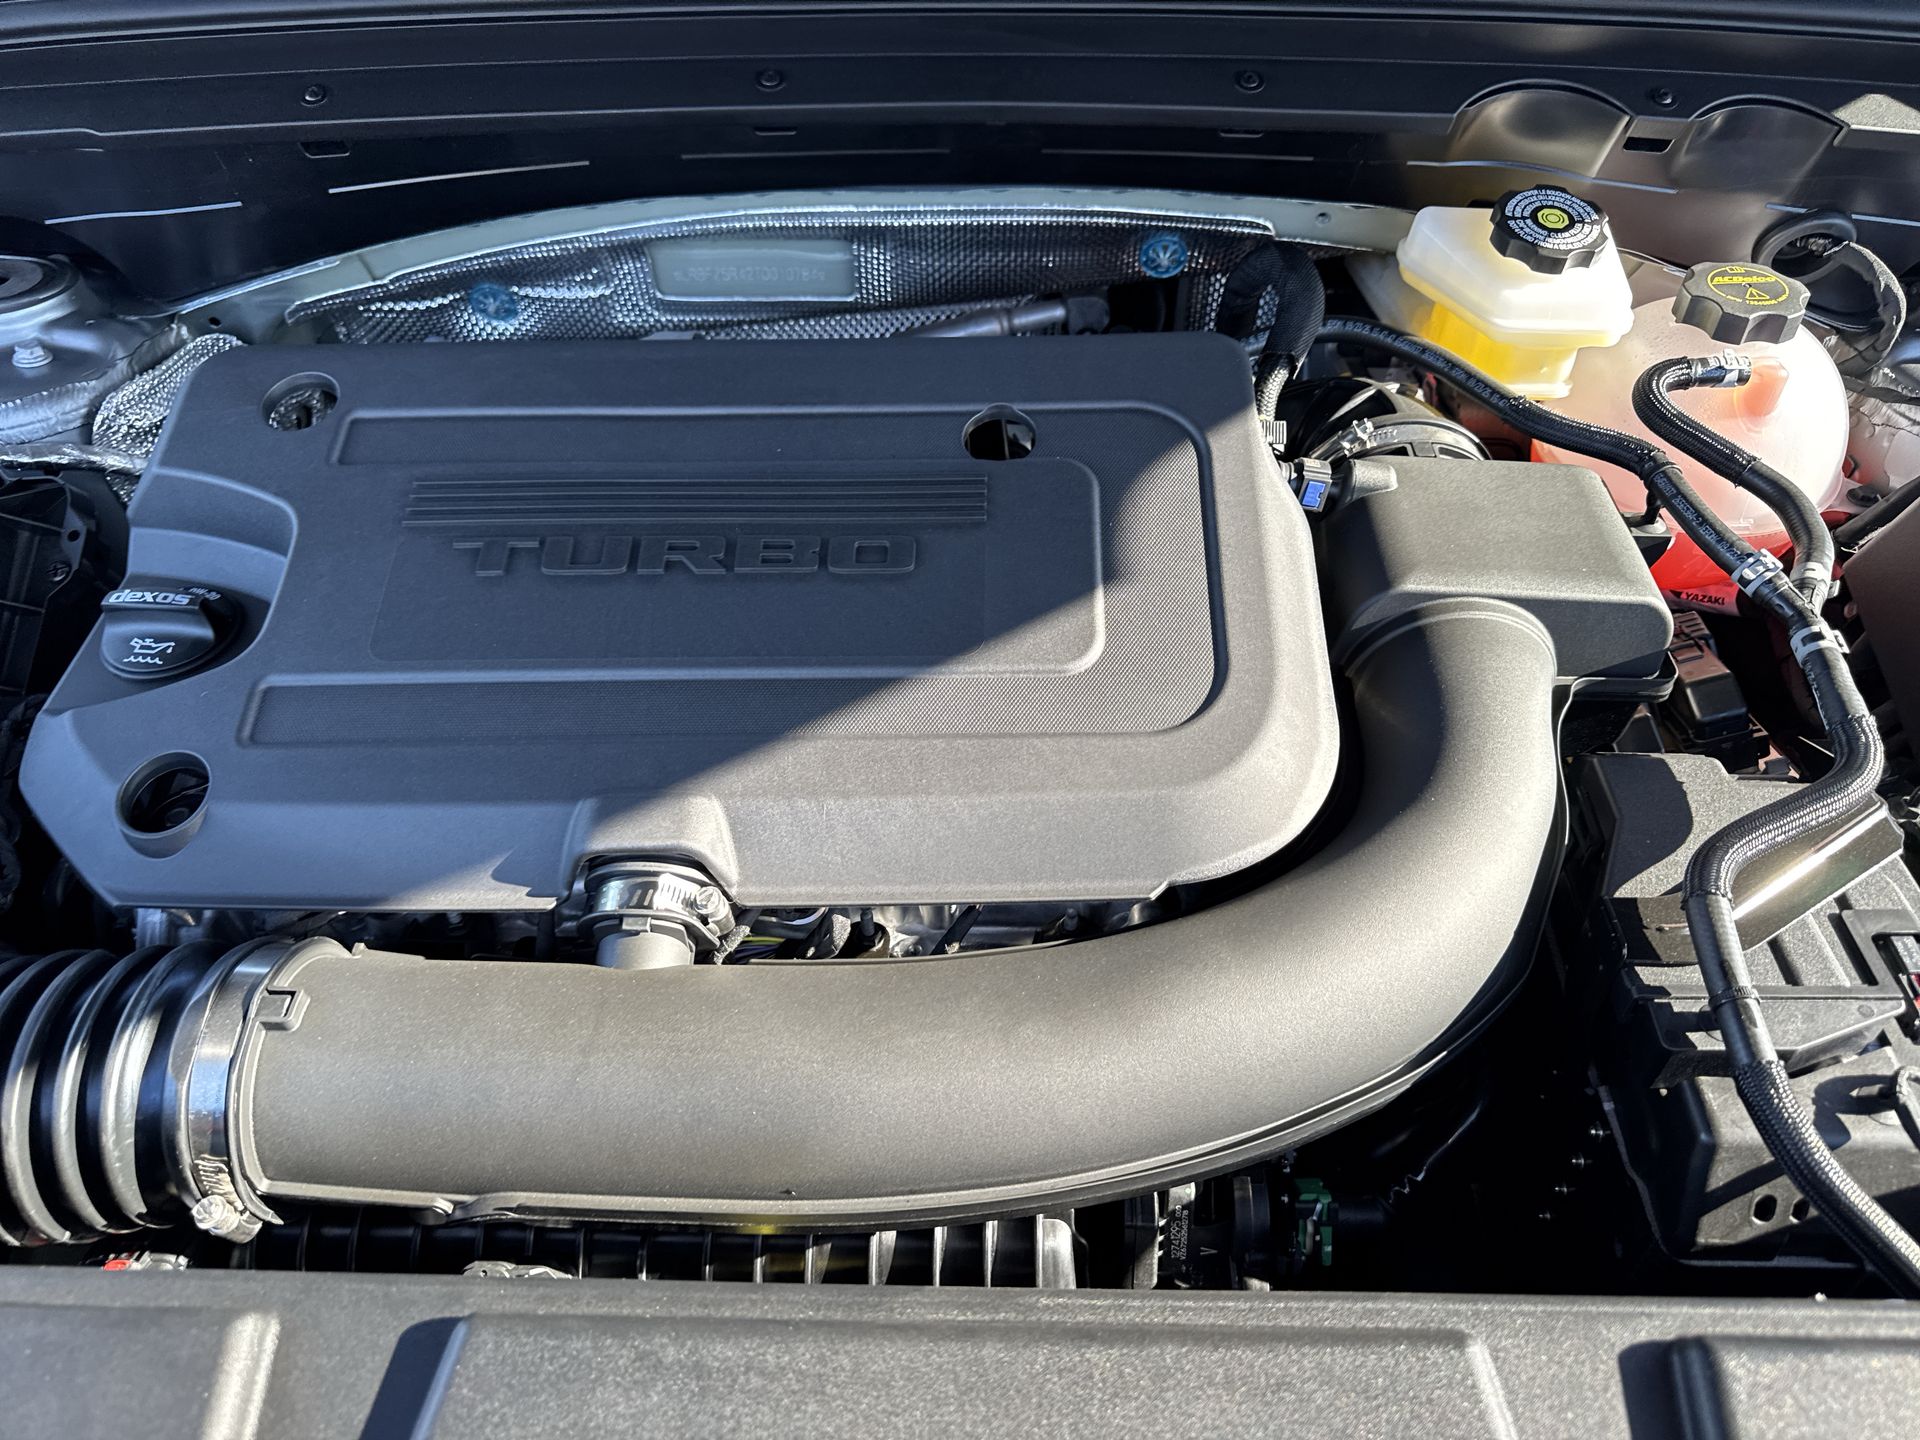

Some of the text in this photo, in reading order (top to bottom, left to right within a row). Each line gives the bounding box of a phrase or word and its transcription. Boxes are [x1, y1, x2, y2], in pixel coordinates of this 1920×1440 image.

[1523, 228, 1545, 241] BEFORE
[1550, 231, 1571, 239] CLEAN
[1533, 239, 1553, 249] FROM
[1713, 275, 1776, 284] ACDelco
[453, 536, 916, 577] TURBO
[108, 589, 194, 606] dexos
[1685, 591, 1725, 606] YAZAKI
